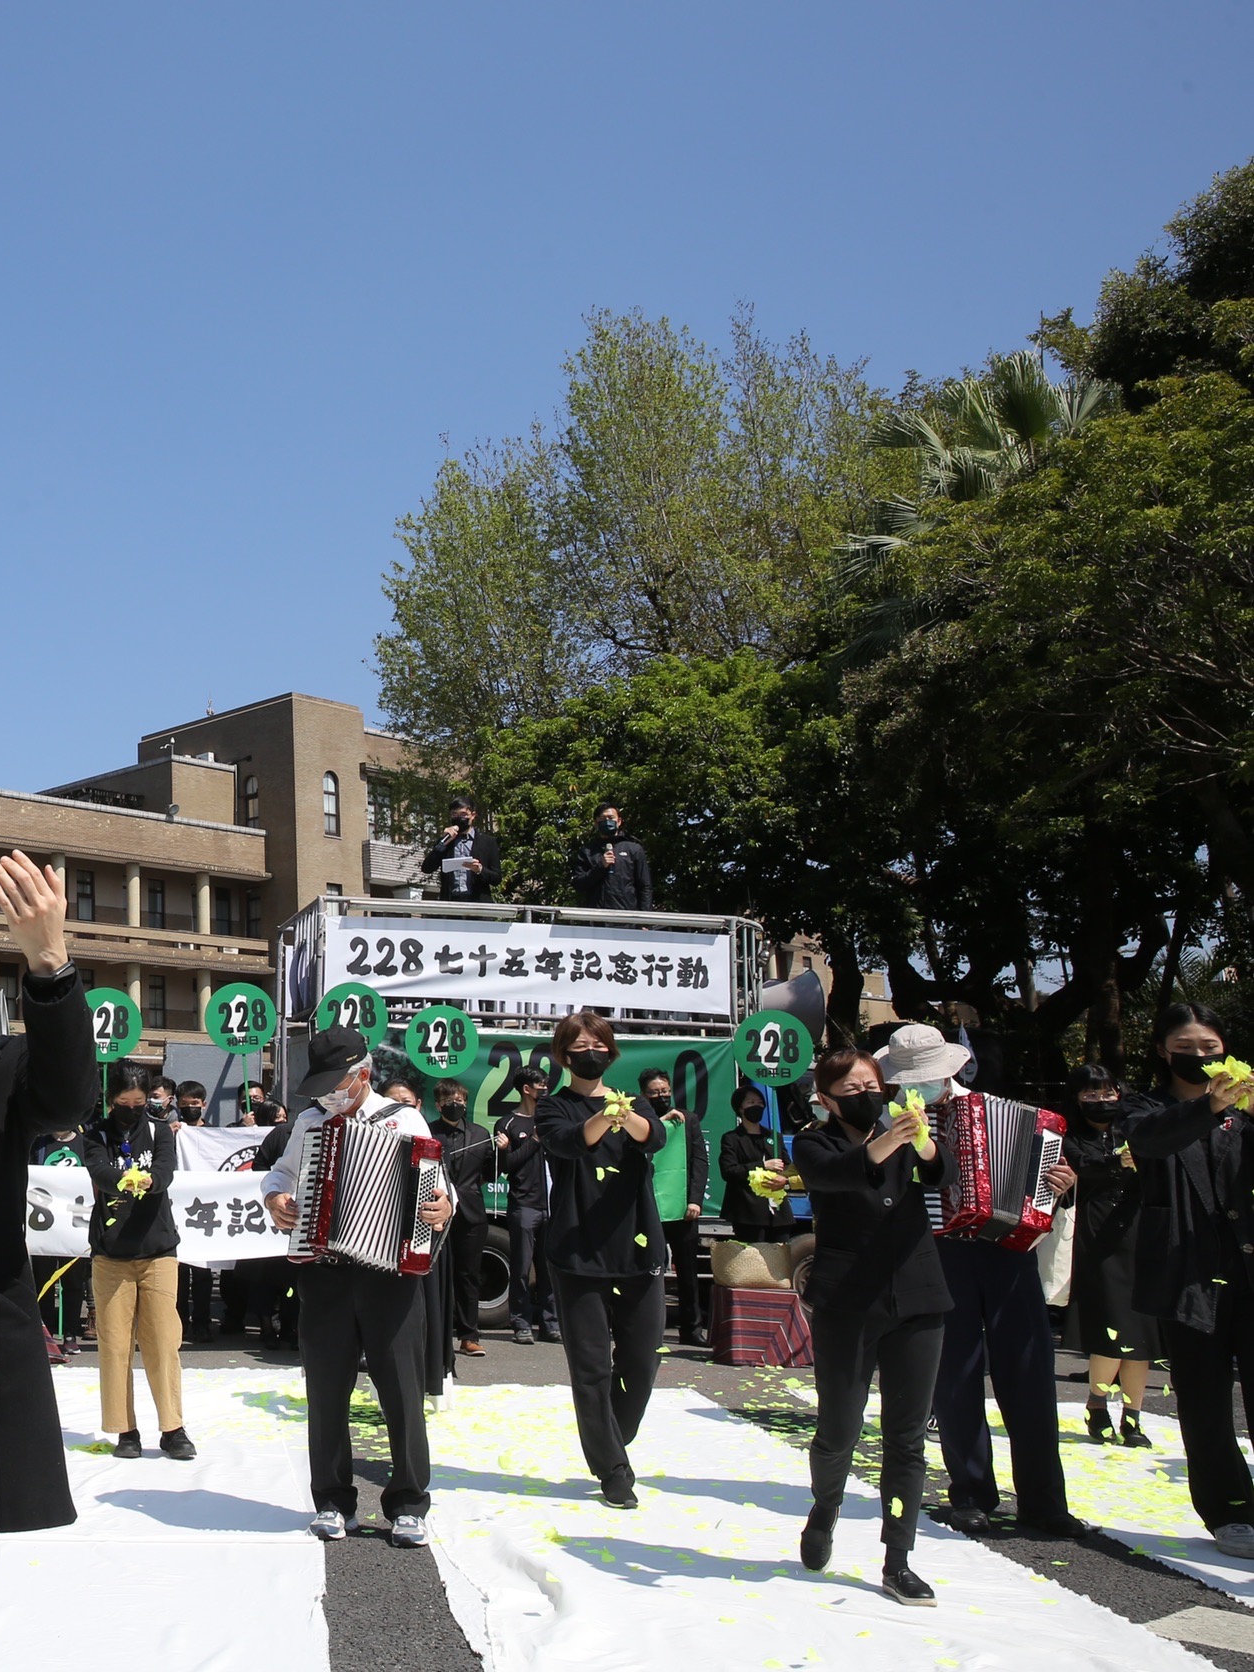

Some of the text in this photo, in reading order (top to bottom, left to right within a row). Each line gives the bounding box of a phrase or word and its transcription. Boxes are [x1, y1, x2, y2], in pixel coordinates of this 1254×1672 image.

[90, 1005, 129, 1040] 28
[218, 998, 268, 1034] 228
[97, 1042, 119, 1052] 平日
[226, 1036, 259, 1048] 和平日
[416, 1018, 467, 1054] 228
[746, 1028, 799, 1064] 228
[426, 1055, 458, 1066] 和平日
[756, 1067, 791, 1078] 和平日
